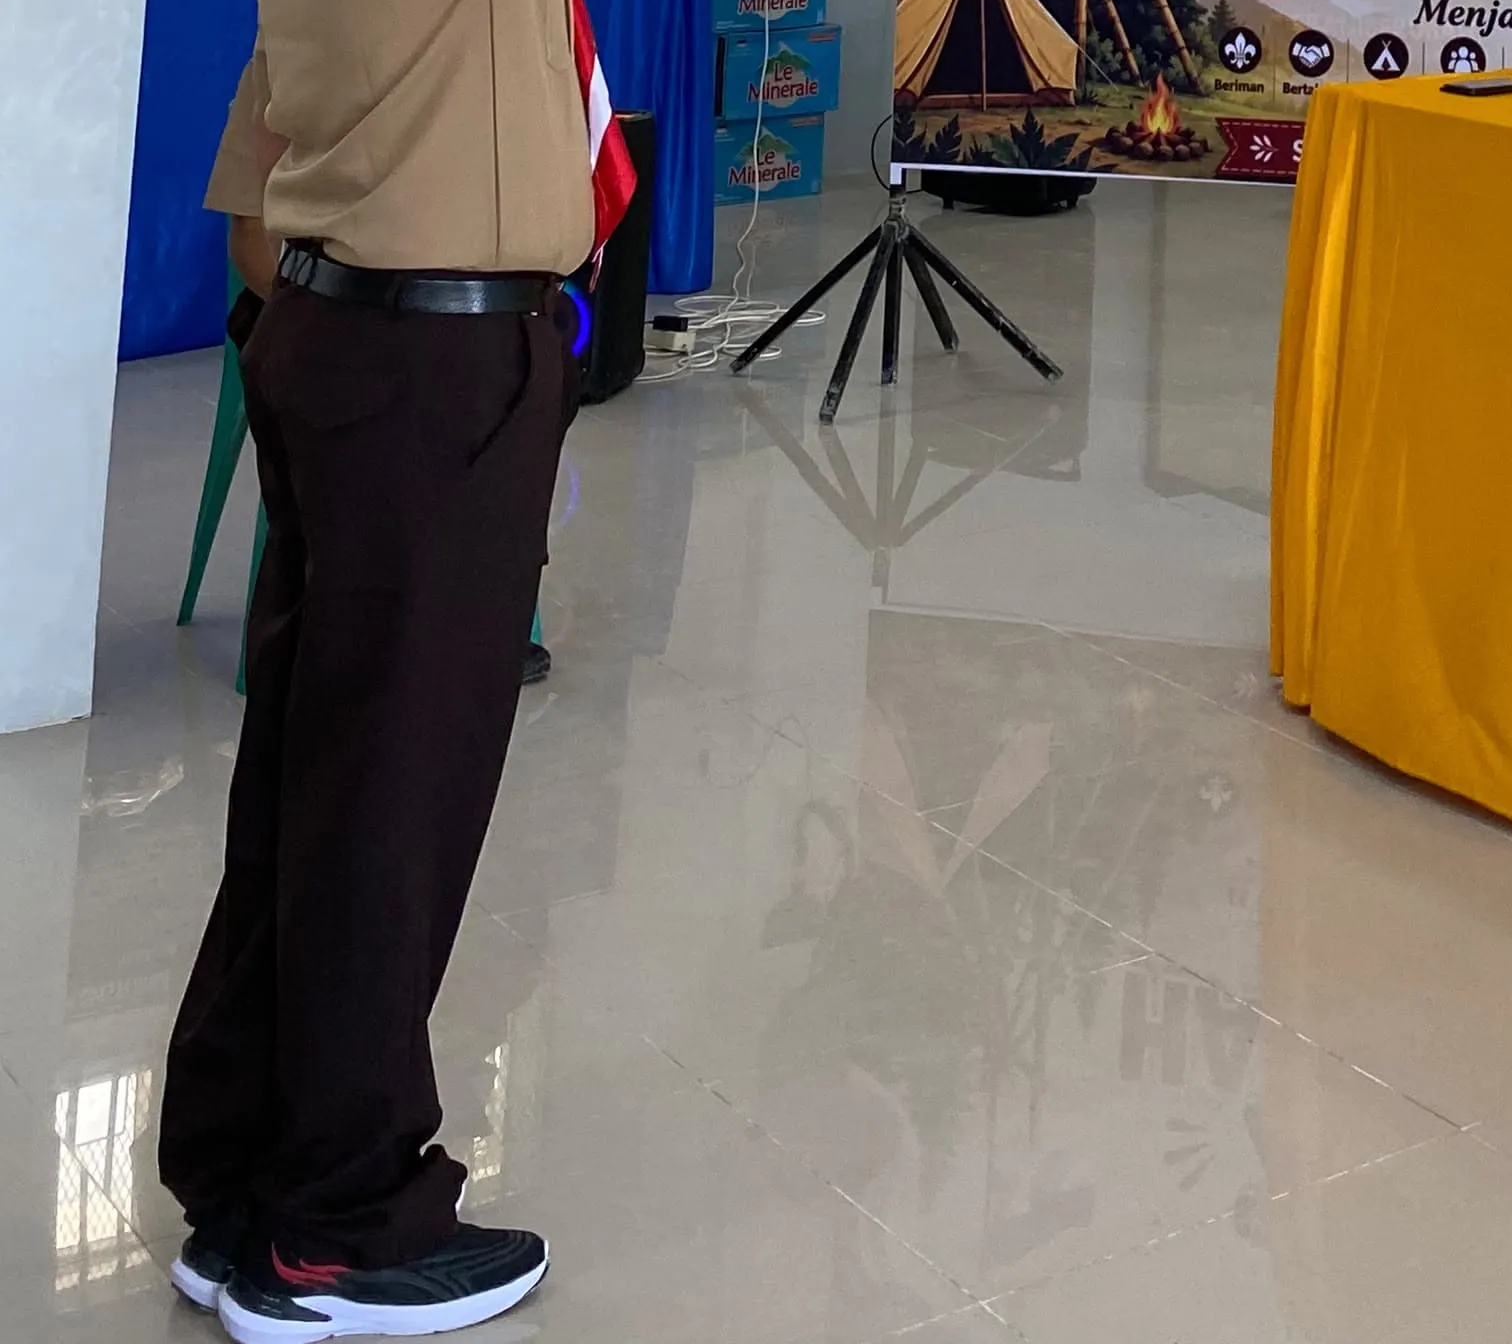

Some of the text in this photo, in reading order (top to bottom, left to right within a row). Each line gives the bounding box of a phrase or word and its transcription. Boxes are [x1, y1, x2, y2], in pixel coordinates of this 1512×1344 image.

[774, 62, 793, 81] Le
[748, 77, 818, 102] Minerale
[1214, 79, 1264, 93] Beriman
[728, 161, 800, 185] Minerale
